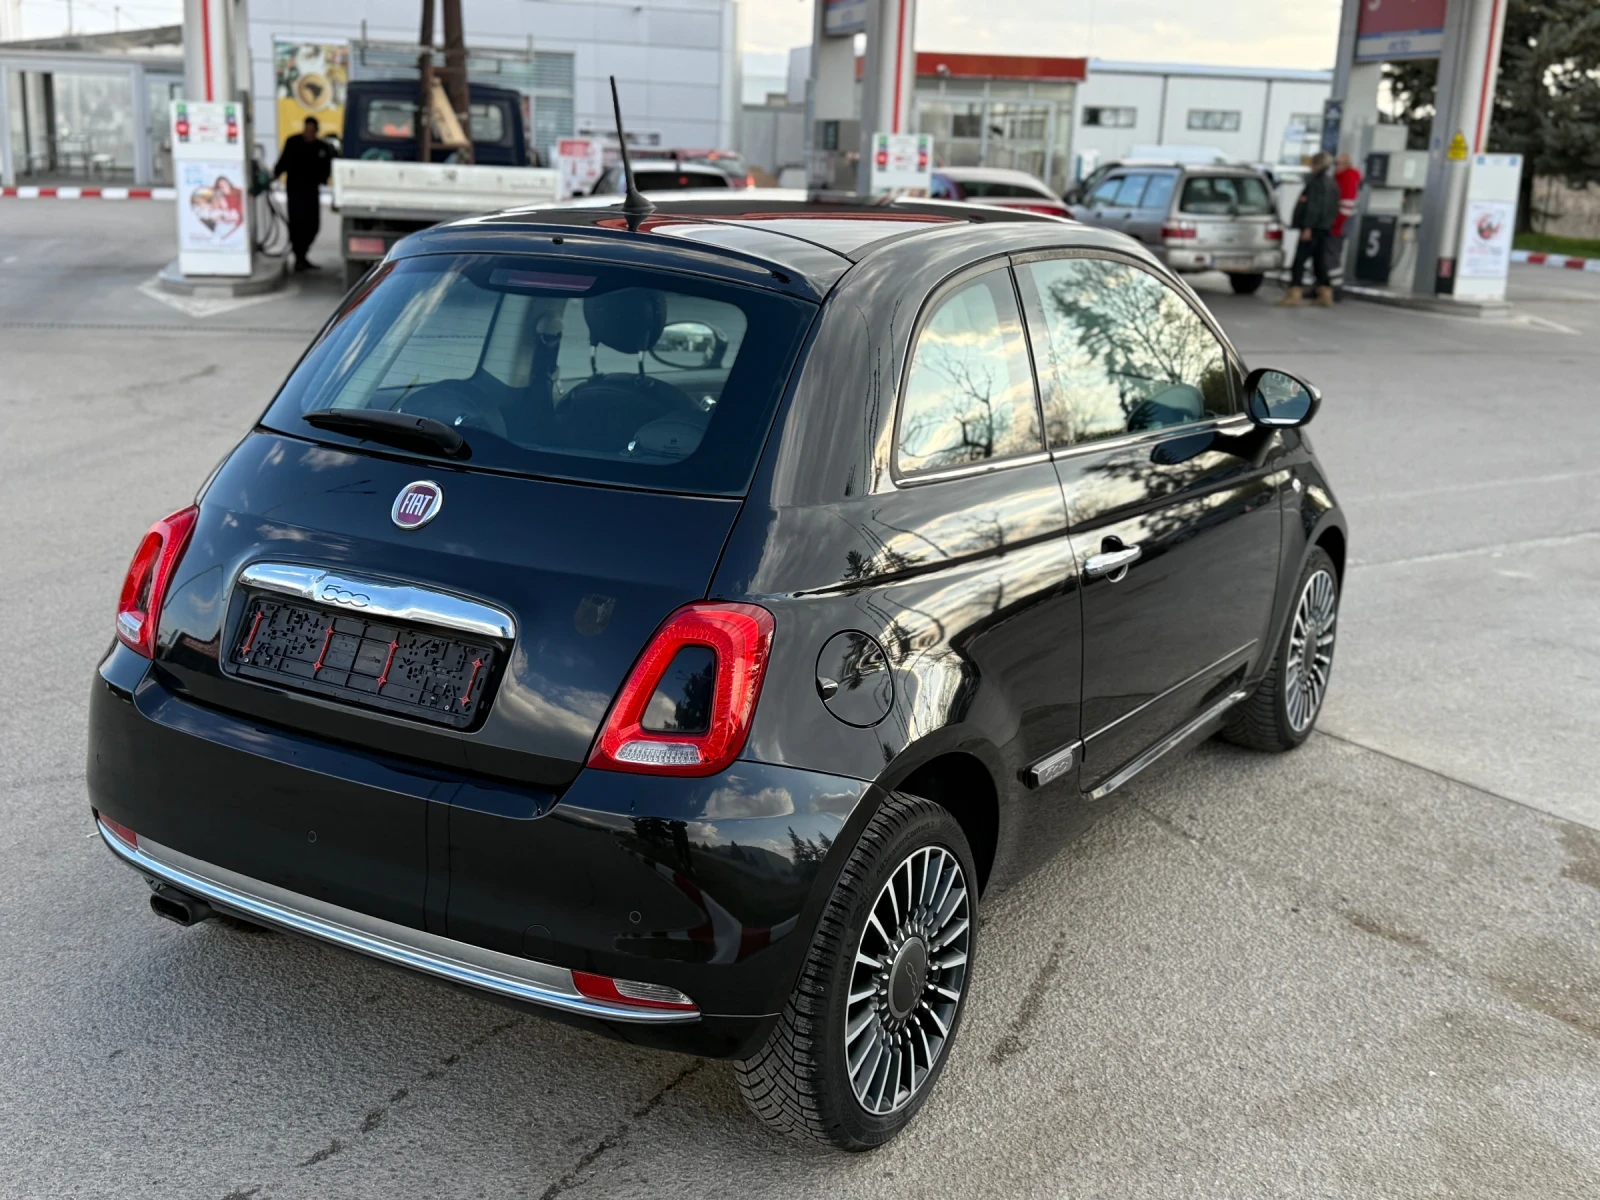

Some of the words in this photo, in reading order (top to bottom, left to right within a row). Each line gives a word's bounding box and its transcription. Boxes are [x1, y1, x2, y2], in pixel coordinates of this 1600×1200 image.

[1365, 229, 1382, 258] 5
[400, 492, 433, 516] FIAT
[321, 584, 371, 608] 500
[876, 822, 930, 878] AllSeasonContact
